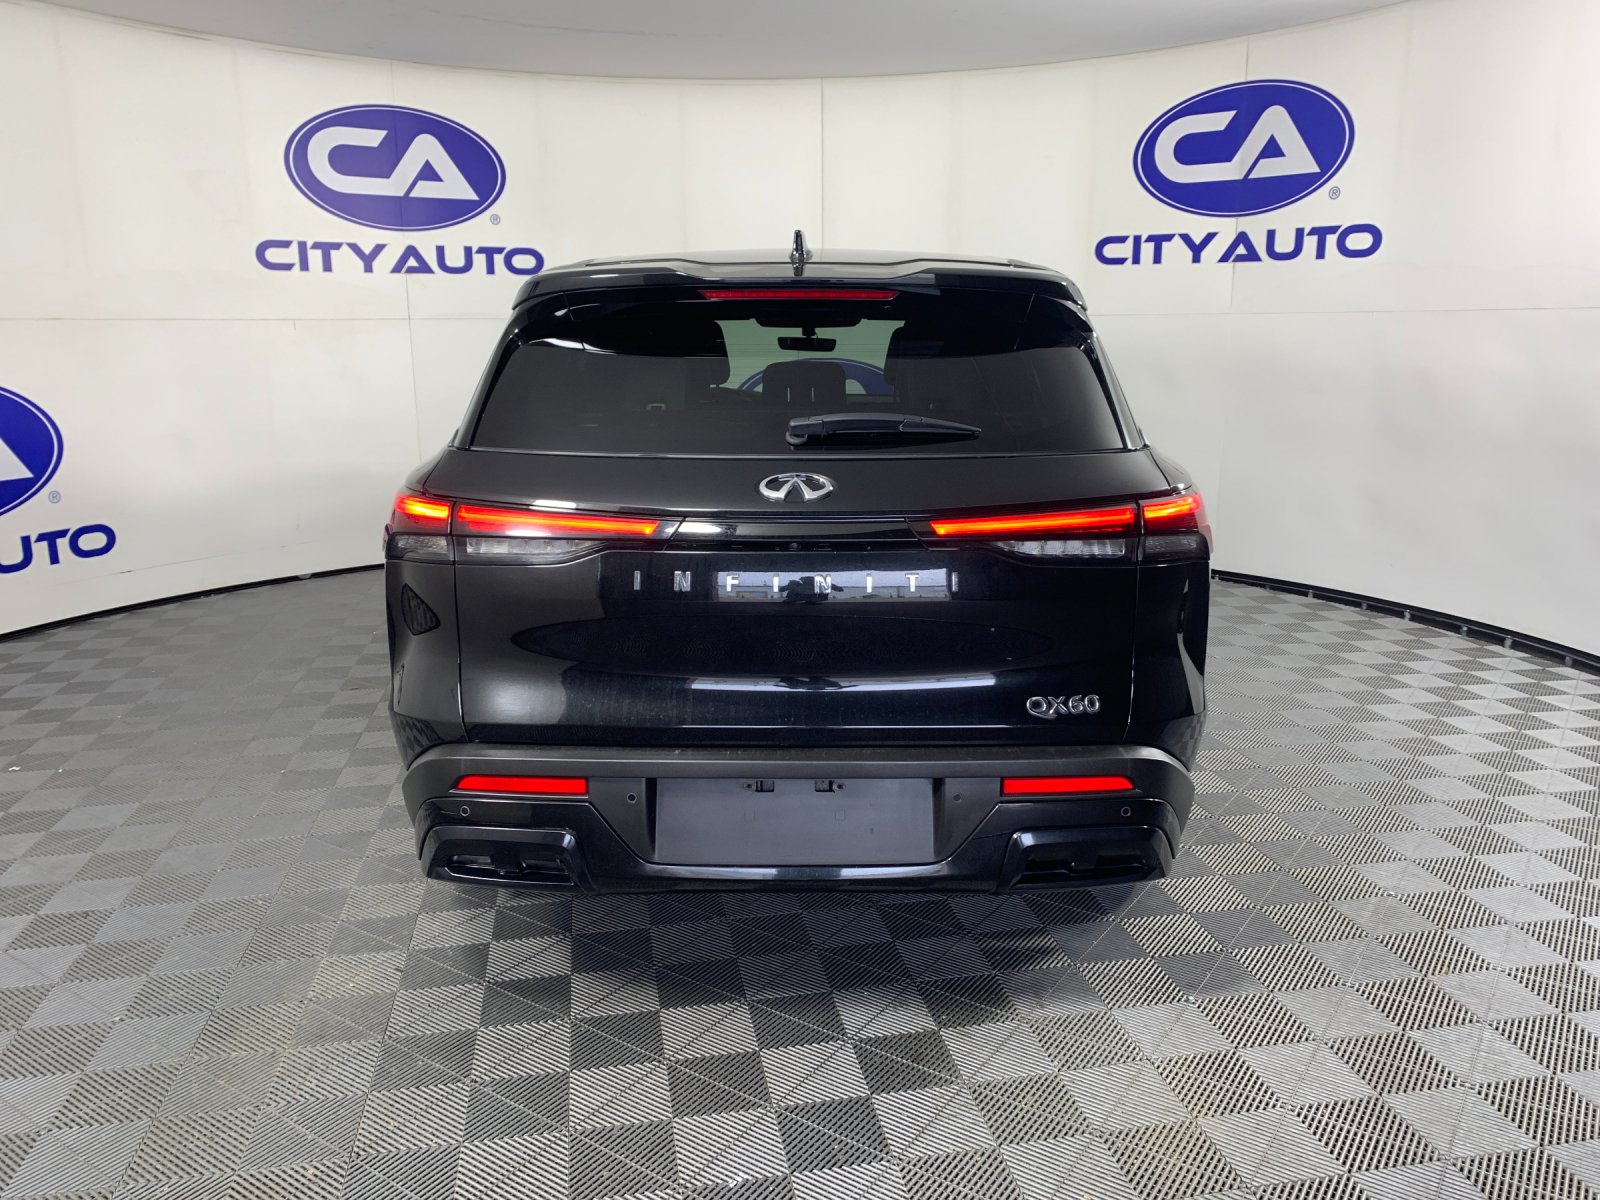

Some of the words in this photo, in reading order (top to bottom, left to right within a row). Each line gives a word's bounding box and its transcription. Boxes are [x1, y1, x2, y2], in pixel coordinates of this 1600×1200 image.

[307, 125, 480, 200] CA
[1154, 104, 1321, 184] CA
[255, 239, 388, 273] CITY
[389, 244, 545, 276] AUTO
[1094, 231, 1219, 265] CITY
[1217, 223, 1383, 264] AUTO
[633, 570, 958, 592] INFINITI
[1026, 694, 1100, 719] QX60
